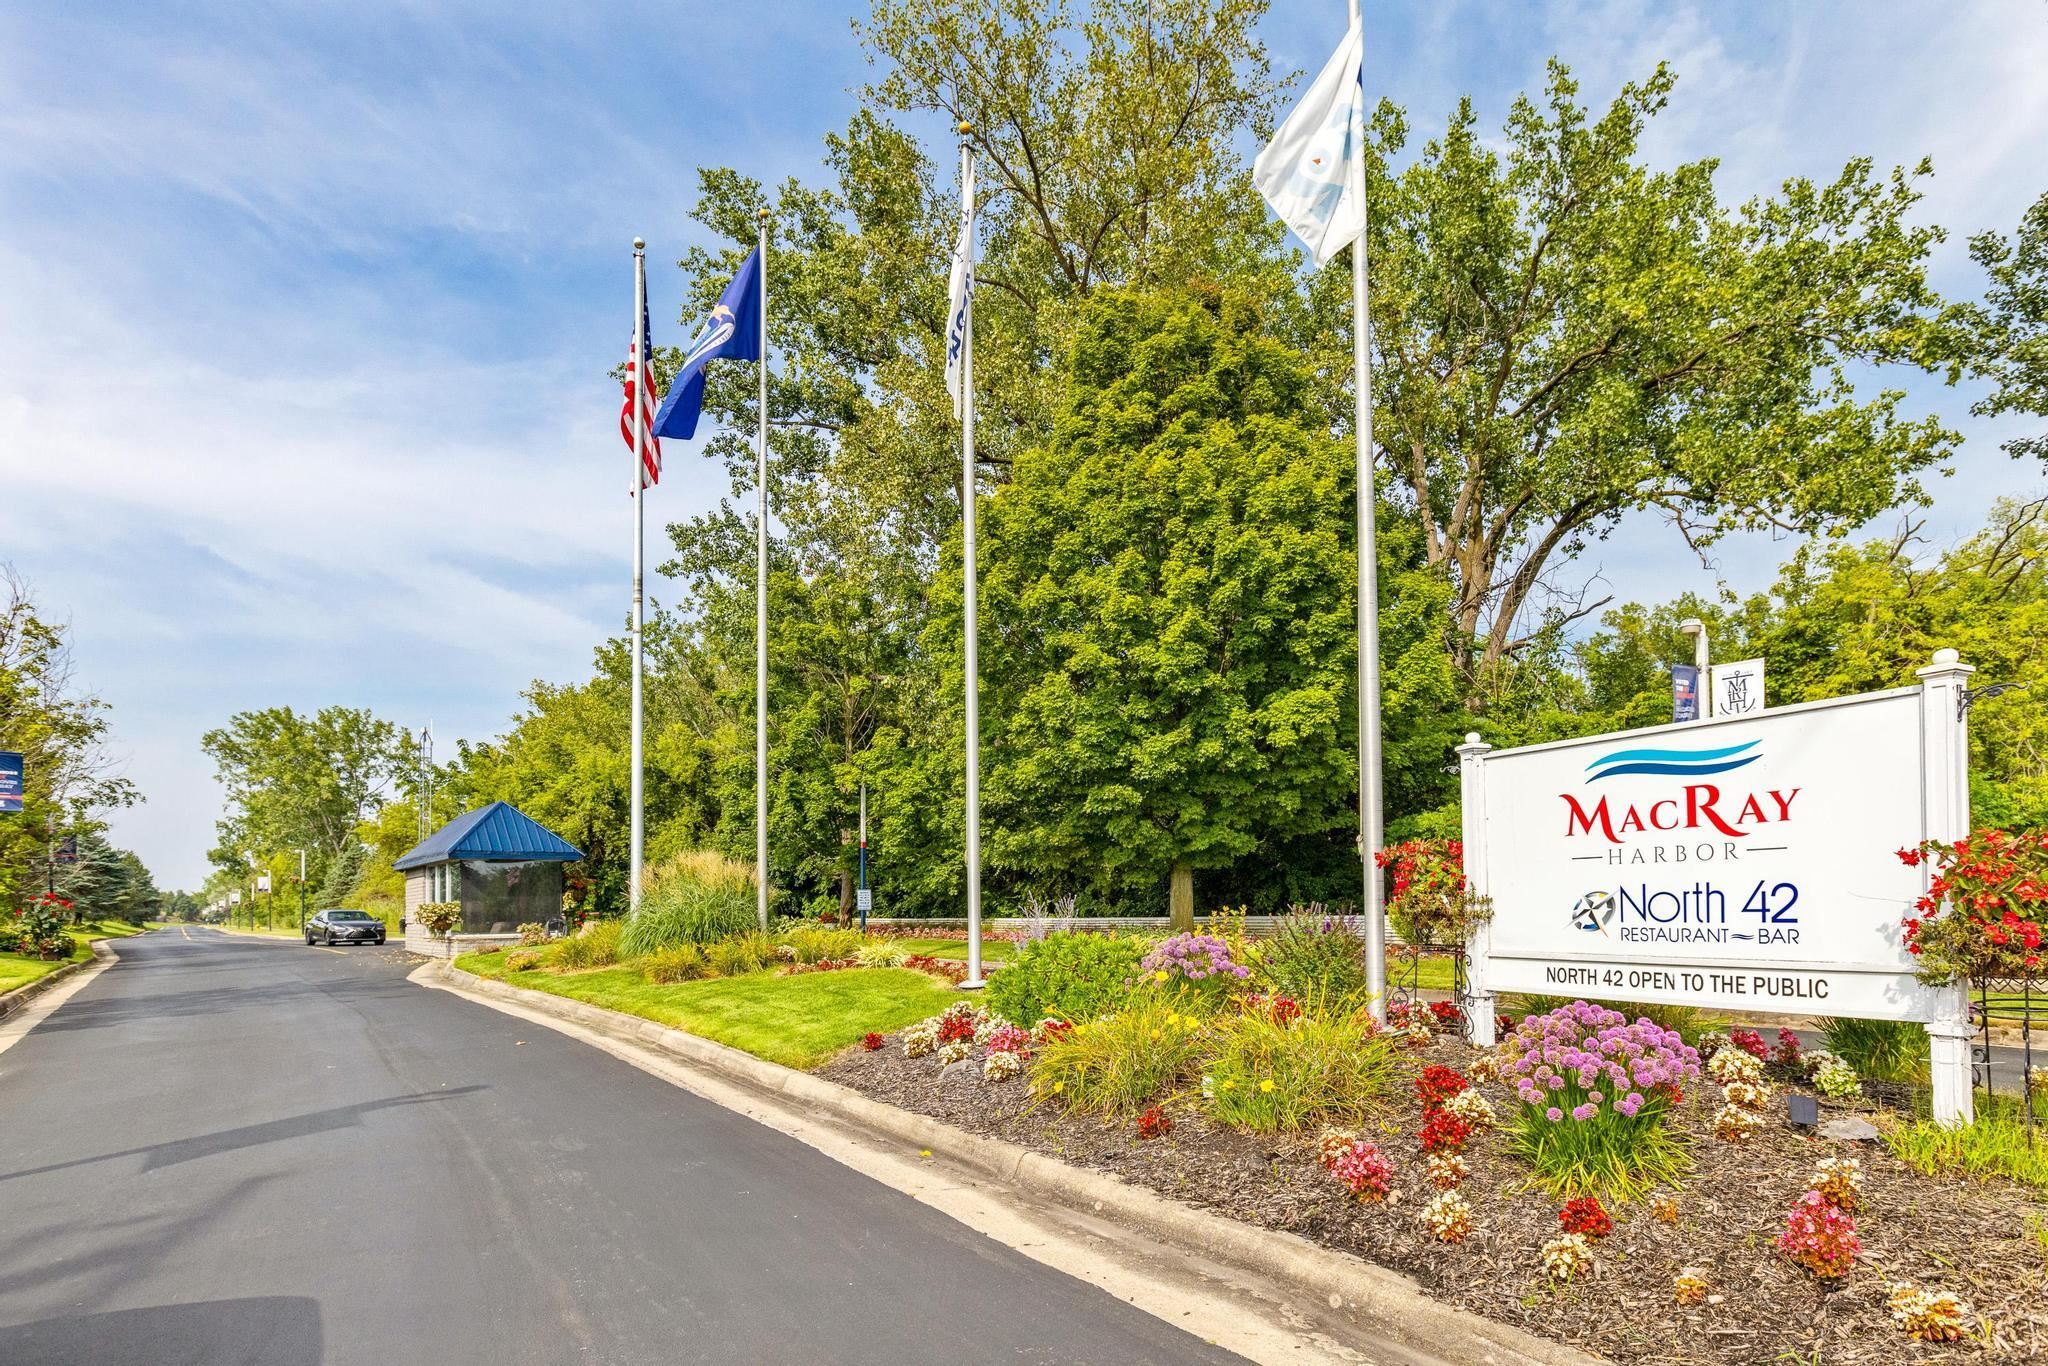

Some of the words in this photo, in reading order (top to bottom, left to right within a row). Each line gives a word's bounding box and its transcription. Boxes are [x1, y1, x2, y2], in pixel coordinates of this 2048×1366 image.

[1608, 842, 1739, 865] HARBOR
[1620, 882, 1725, 923] North
[1741, 880, 1799, 923] 42
[1620, 927, 1729, 943] RESTAURANT
[1758, 928, 1800, 945] BAR
[1546, 966, 1597, 985] NORTH
[1602, 970, 1623, 987] 42
[1629, 970, 1675, 990] OPEN
[1681, 973, 1704, 992] TO
[1709, 974, 1746, 994] THE
[1753, 976, 1829, 999] PUBLIC
